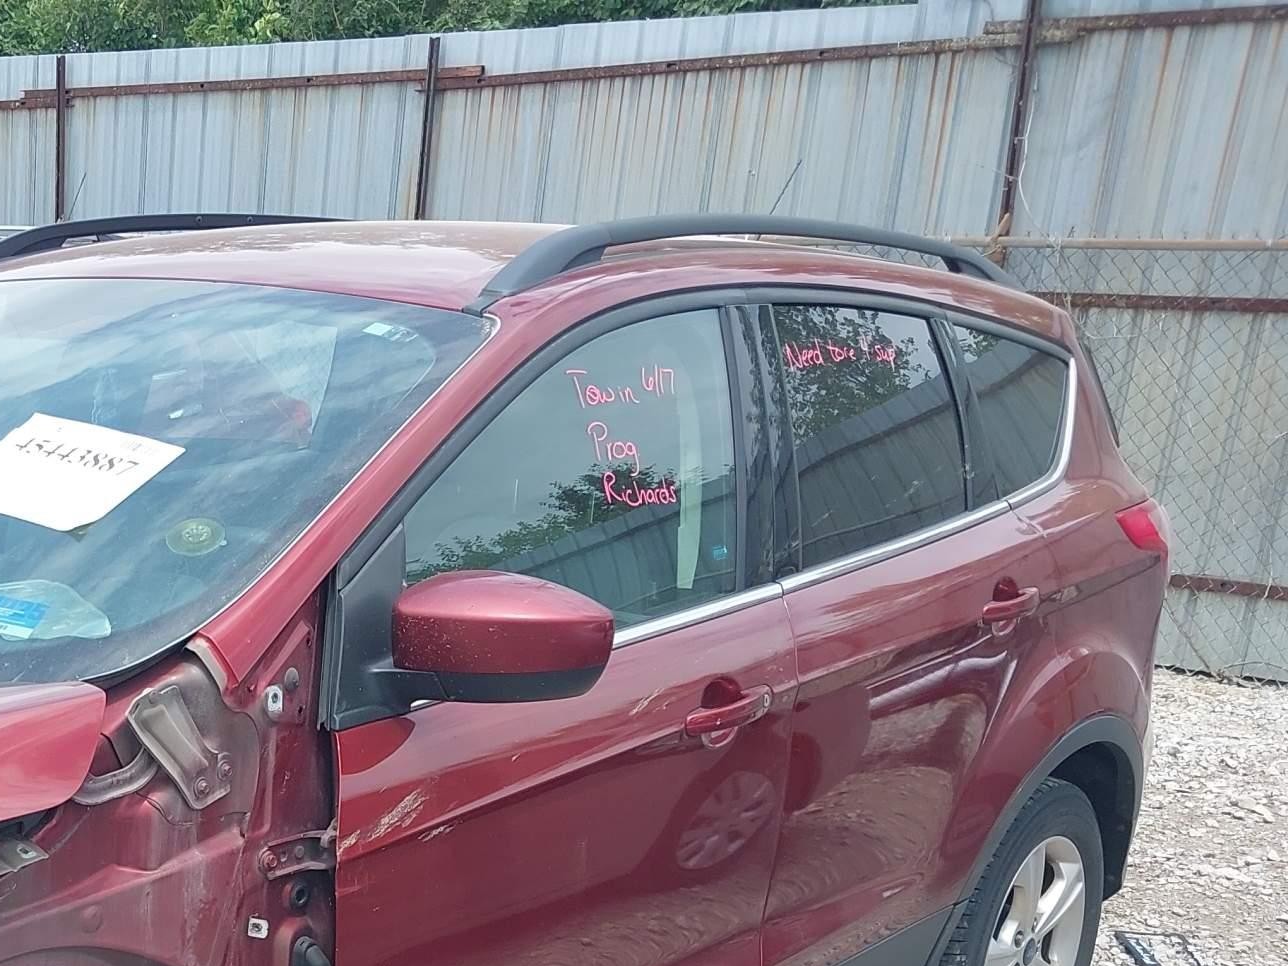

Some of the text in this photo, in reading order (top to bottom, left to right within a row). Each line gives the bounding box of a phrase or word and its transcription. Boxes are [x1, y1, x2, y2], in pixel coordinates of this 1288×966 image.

[783, 338, 824, 371] Need
[587, 420, 641, 477] Prog
[603, 471, 677, 507] Richards
